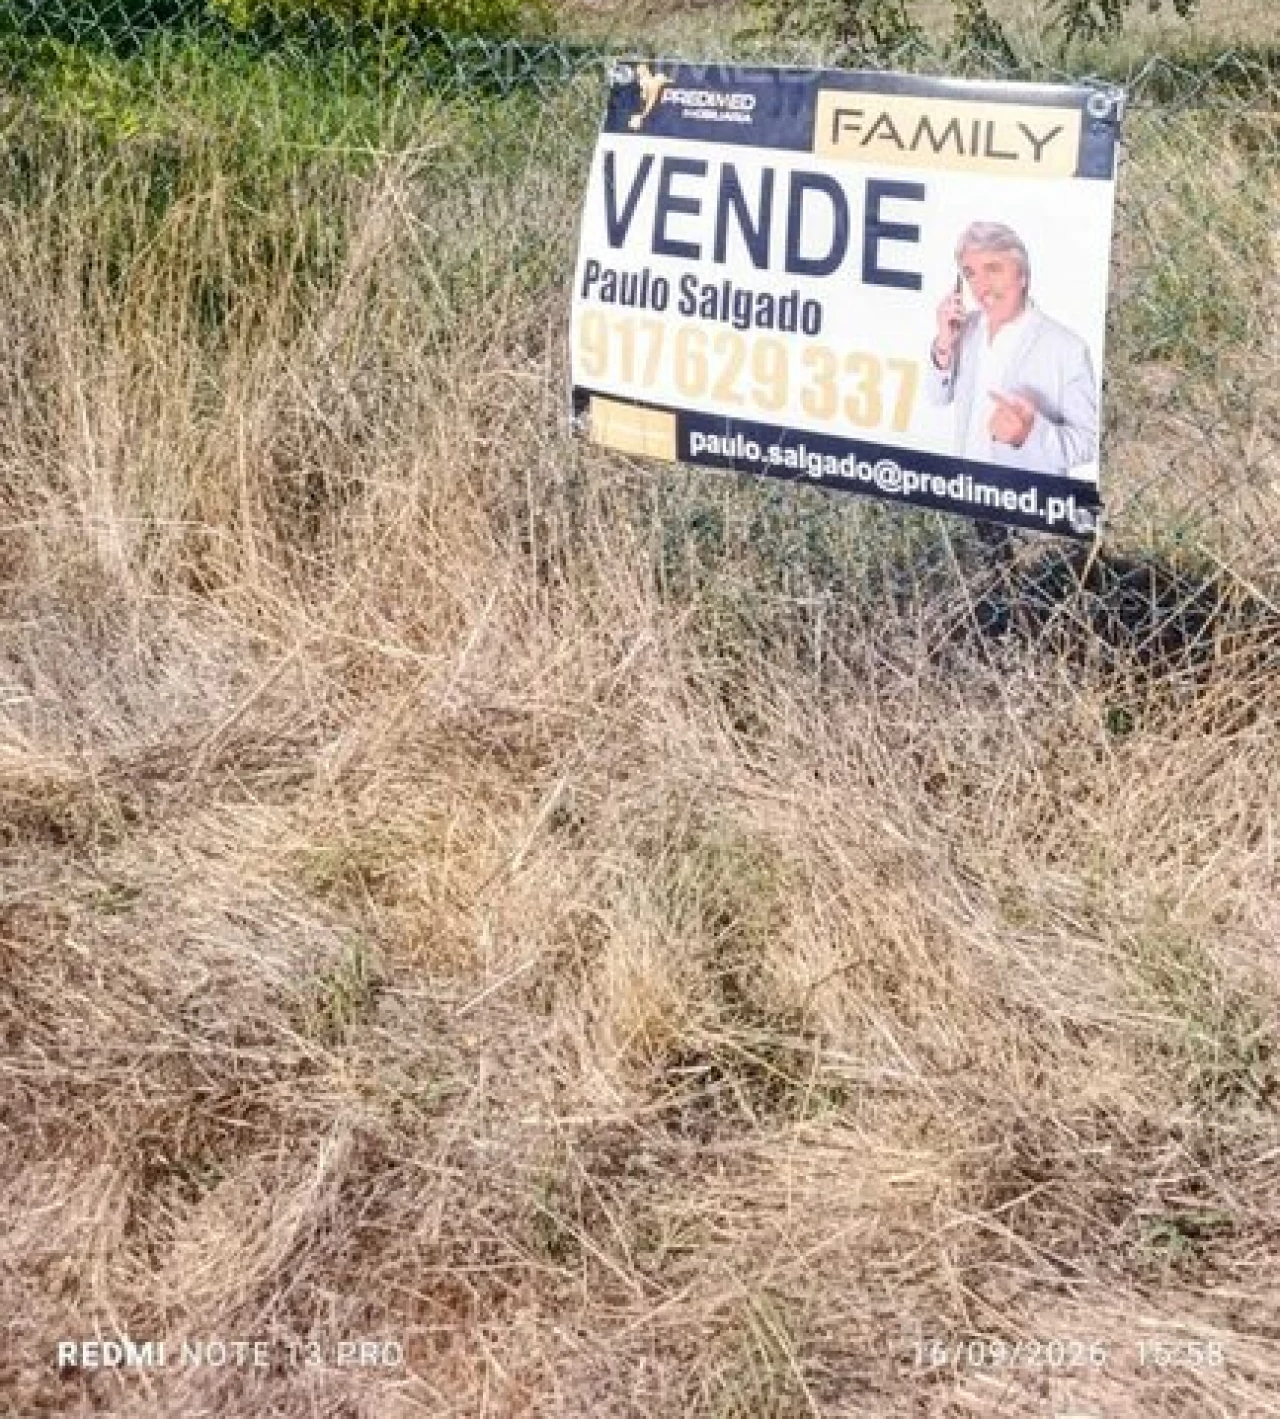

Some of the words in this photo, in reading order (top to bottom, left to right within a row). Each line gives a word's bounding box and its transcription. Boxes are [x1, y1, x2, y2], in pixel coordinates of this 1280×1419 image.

[661, 88, 756, 110] PREDIMED
[831, 107, 1064, 163] FAMILY
[602, 150, 925, 290] VENDE
[581, 259, 670, 312] Paulo
[678, 273, 823, 336] Salgado
[579, 312, 665, 386] 917
[673, 325, 789, 411] 629
[802, 344, 920, 433] 337
[690, 431, 1079, 525] paulo.salgado@predimed.pt
